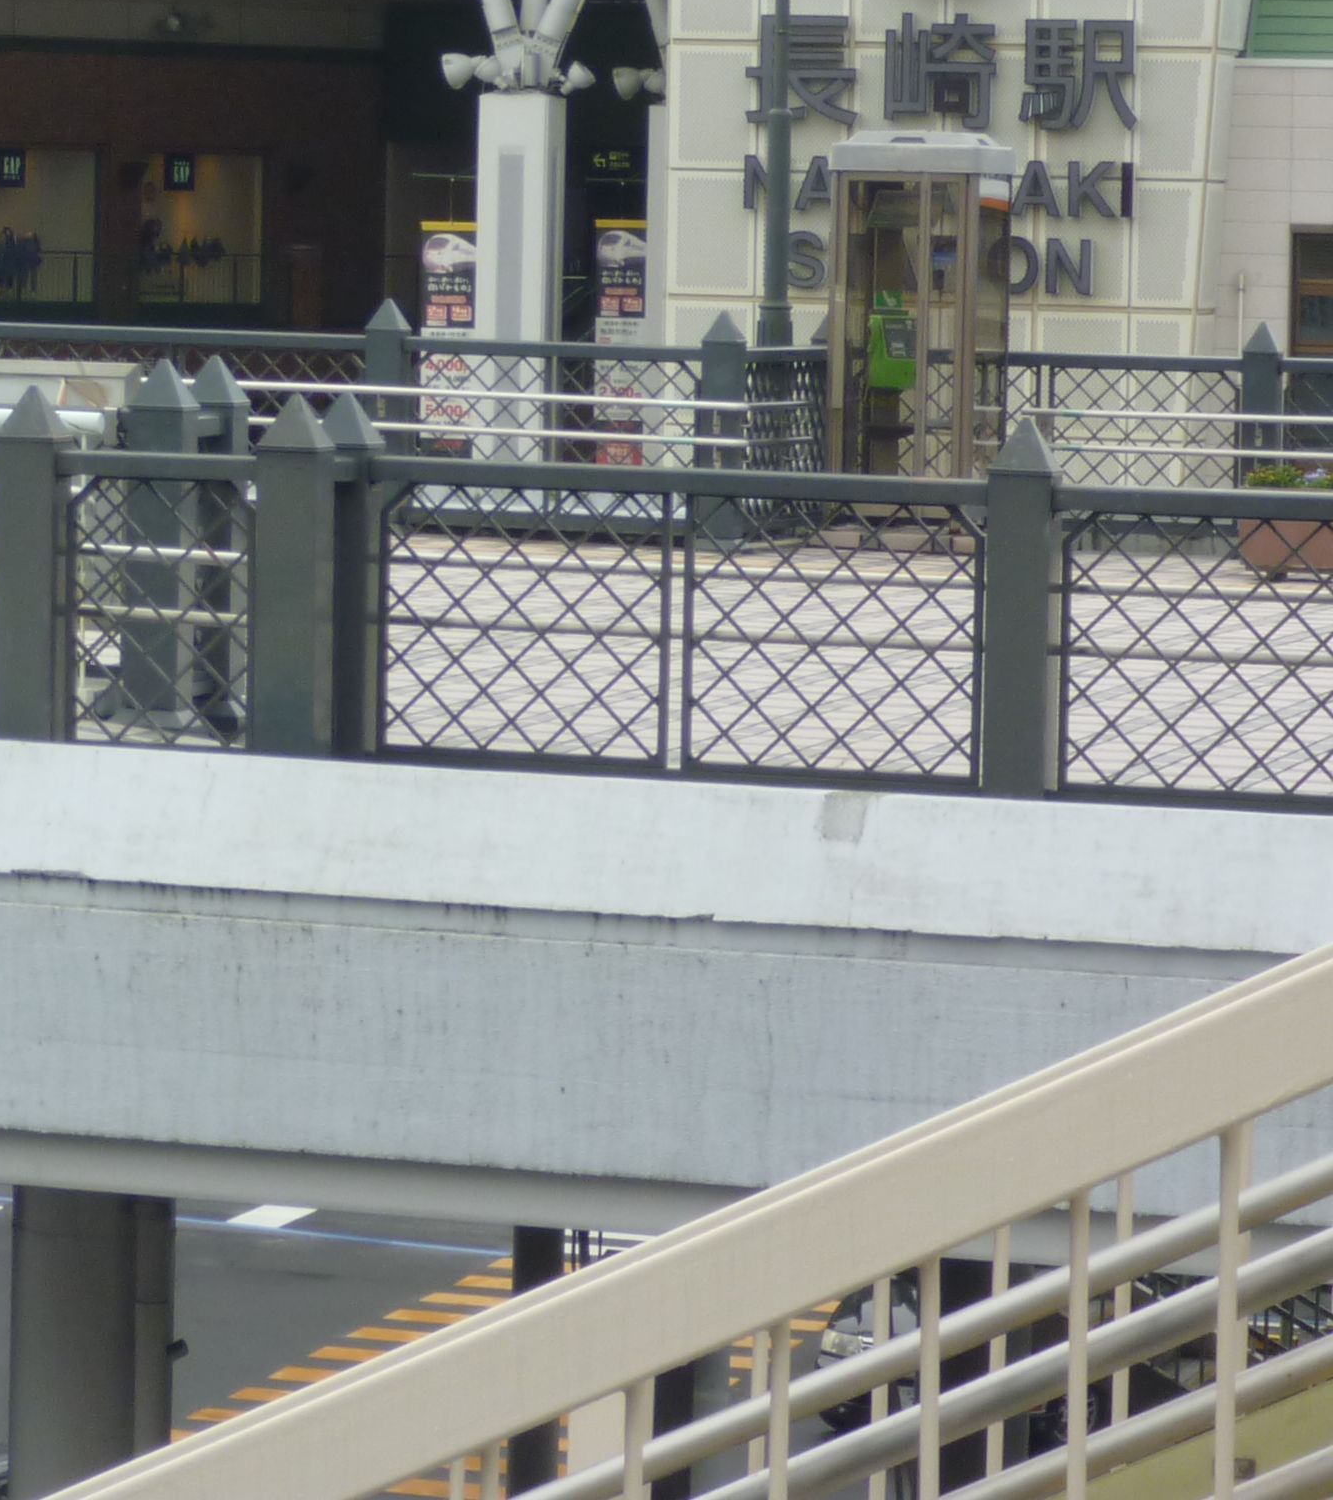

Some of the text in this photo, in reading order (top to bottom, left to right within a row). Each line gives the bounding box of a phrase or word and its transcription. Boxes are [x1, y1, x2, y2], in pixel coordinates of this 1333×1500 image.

[745, 12, 1138, 131] 長崎駅
[4, 156, 21, 175] GAP
[744, 154, 1134, 219] NAAKI
